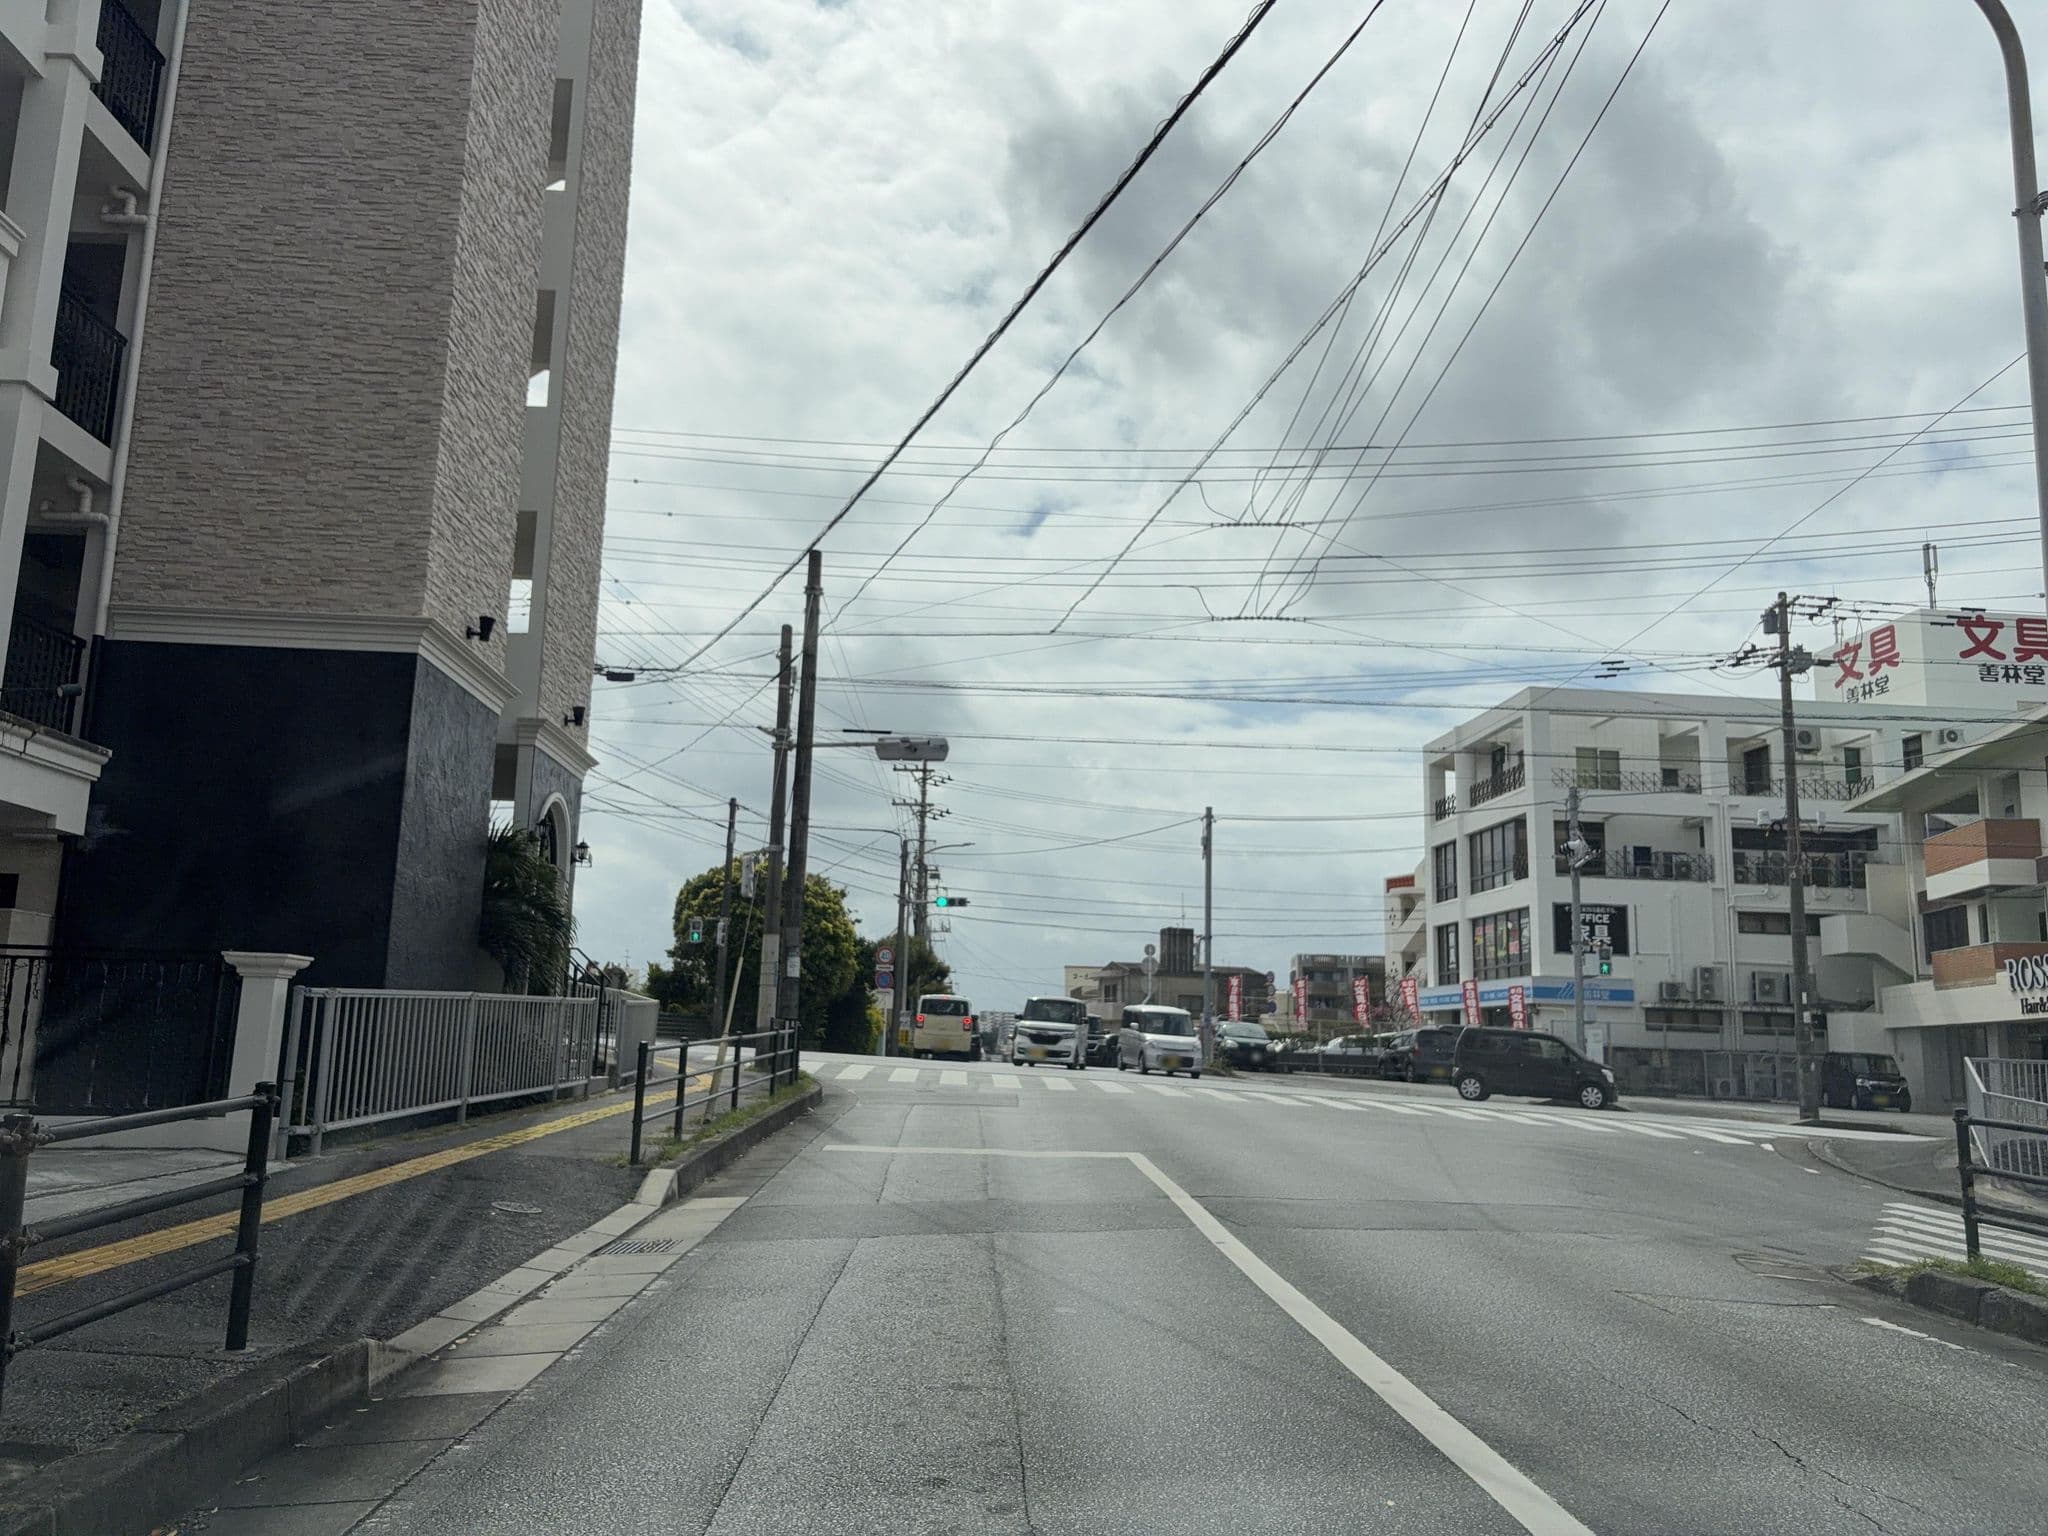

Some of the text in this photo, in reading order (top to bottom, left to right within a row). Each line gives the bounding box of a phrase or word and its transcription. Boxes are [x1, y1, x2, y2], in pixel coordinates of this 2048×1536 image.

[1956, 615, 2048, 663] 文具
[1833, 625, 1900, 688] 文具
[1978, 664, 2046, 685] 善林堂
[1846, 675, 1889, 703] 善林堂
[1580, 913, 1610, 923] FFICE
